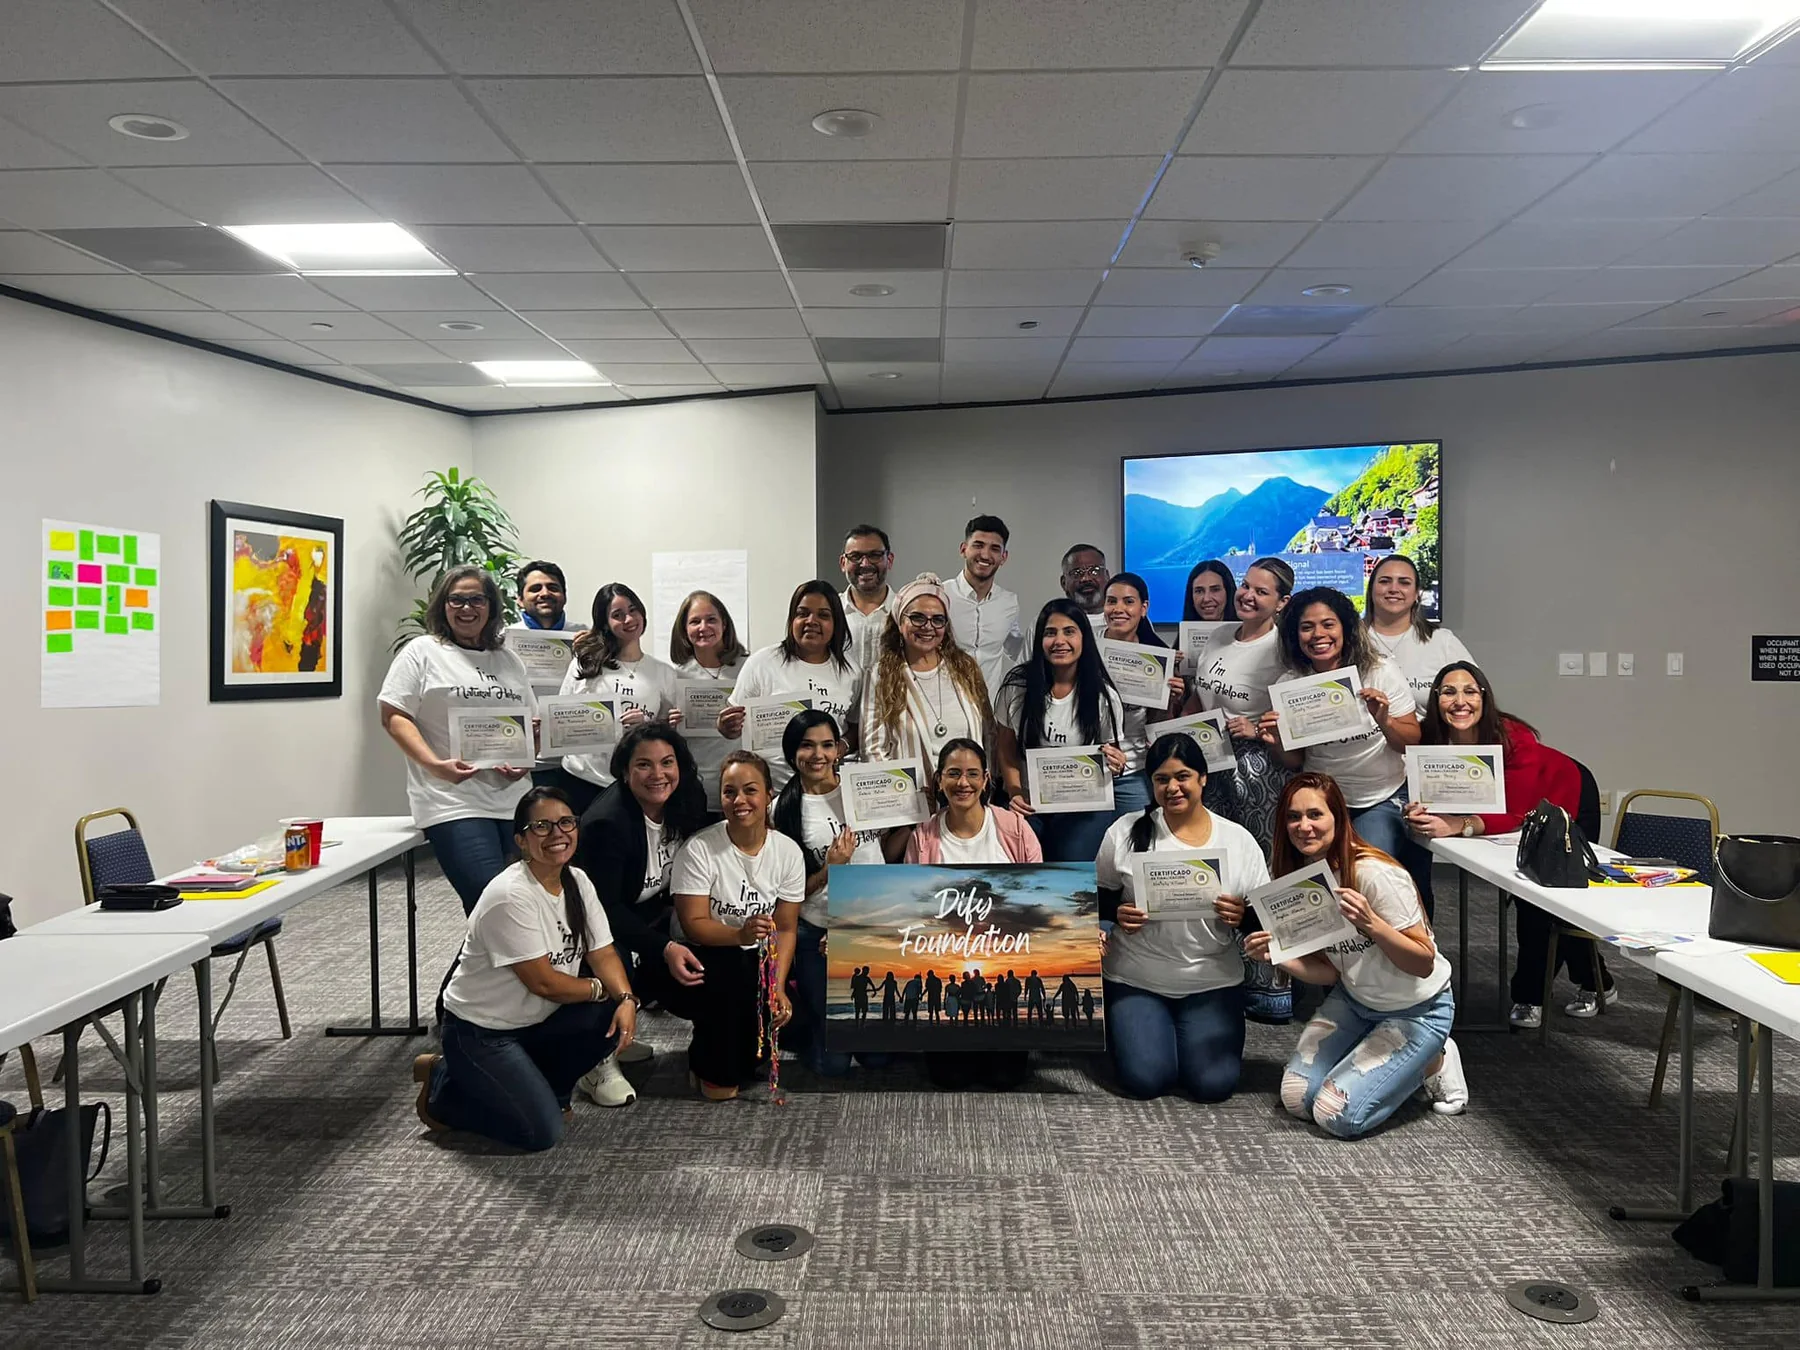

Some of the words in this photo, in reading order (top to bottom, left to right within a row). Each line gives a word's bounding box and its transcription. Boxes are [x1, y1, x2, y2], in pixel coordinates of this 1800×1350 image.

[1108, 656, 1142, 665] CERTIFICADO
[1288, 692, 1326, 705] CERTIFICADO
[756, 710, 790, 719] CERTIFICADO
[856, 778, 892, 787] CERTIFICADO
[1150, 869, 1191, 877] CERTIFICADO
[934, 886, 993, 925] Dify
[1270, 893, 1305, 911] CERTIFICADO
[897, 924, 1030, 957] Foundation
